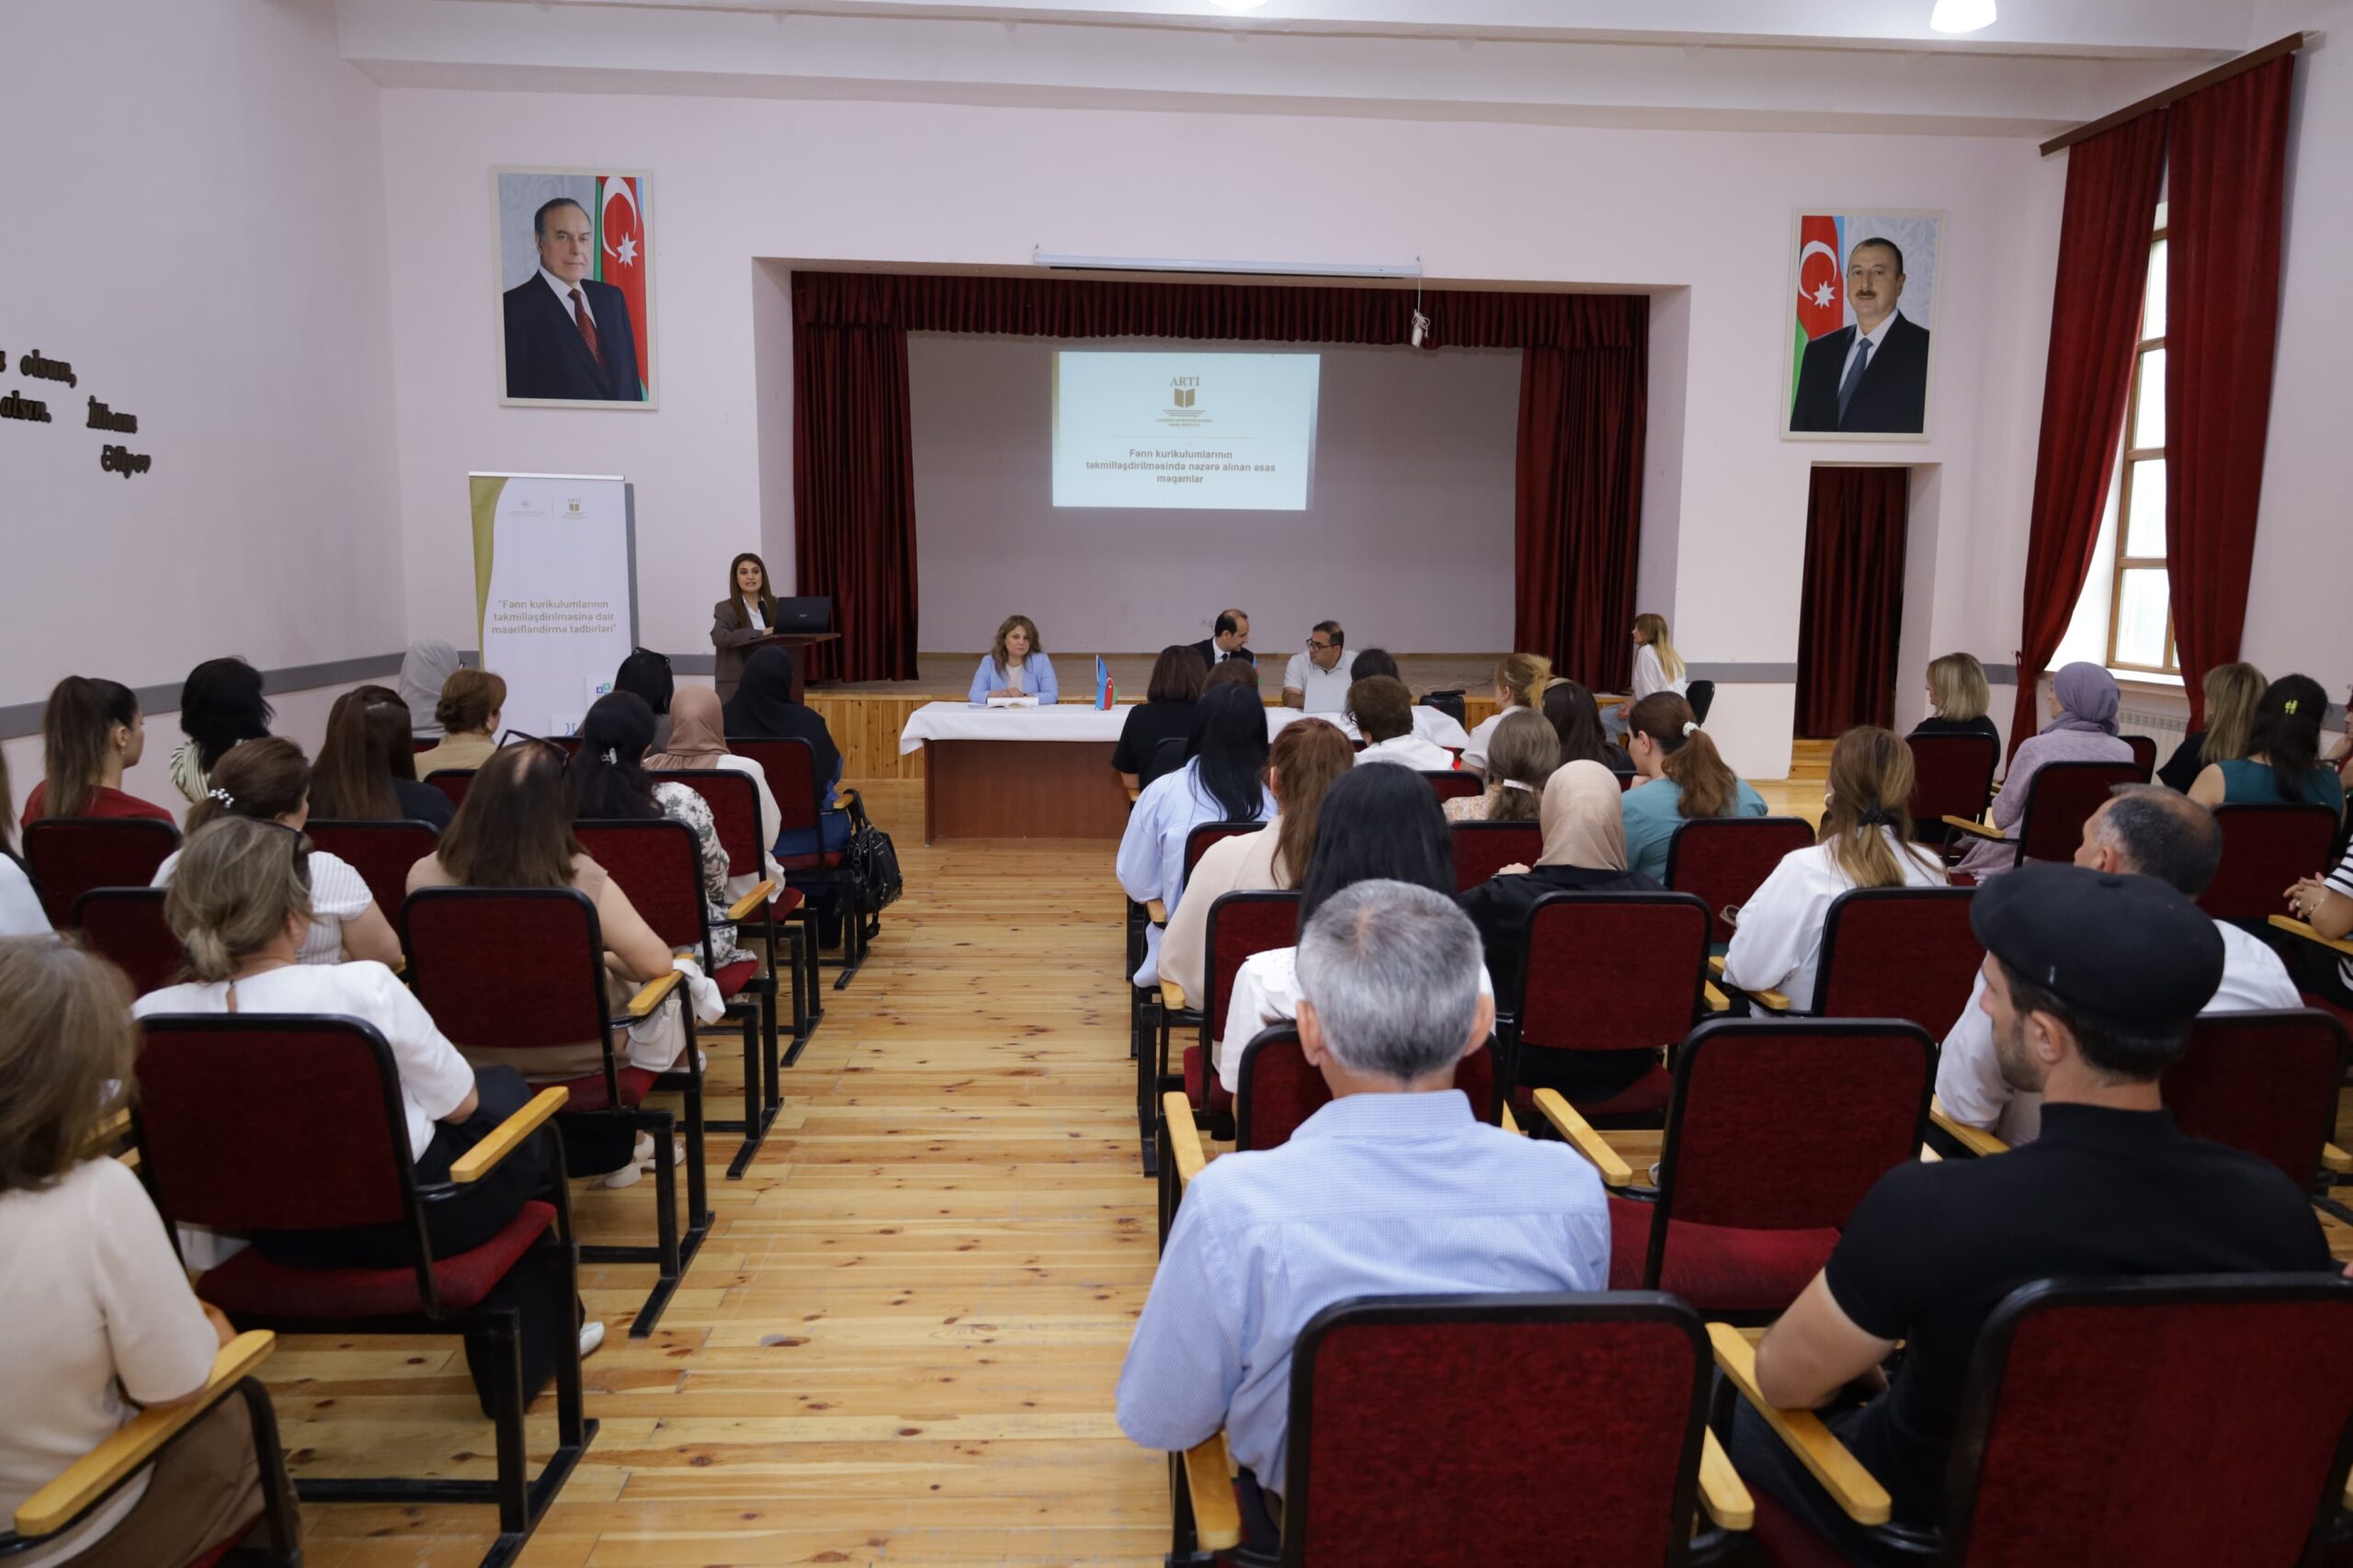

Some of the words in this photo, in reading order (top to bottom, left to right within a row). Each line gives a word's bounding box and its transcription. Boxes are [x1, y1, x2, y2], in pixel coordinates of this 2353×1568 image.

[85, 394, 138, 434] İlham
[1129, 449, 1153, 458] Fənn
[1155, 449, 1233, 460] kurikulumlarının
[1086, 460, 1186, 472] təkmilləşdirilməsində
[1188, 463, 1220, 472] nəzərə
[1222, 462, 1251, 472] alınan
[1254, 464, 1276, 472] əsas
[1156, 474, 1204, 484] məqamlar
[529, 599, 608, 609] kurikulumlarının
[494, 612, 593, 623] təkmilləşdirilməsinə
[596, 612, 614, 621] dair
[492, 624, 567, 634] maarifləndirmə
